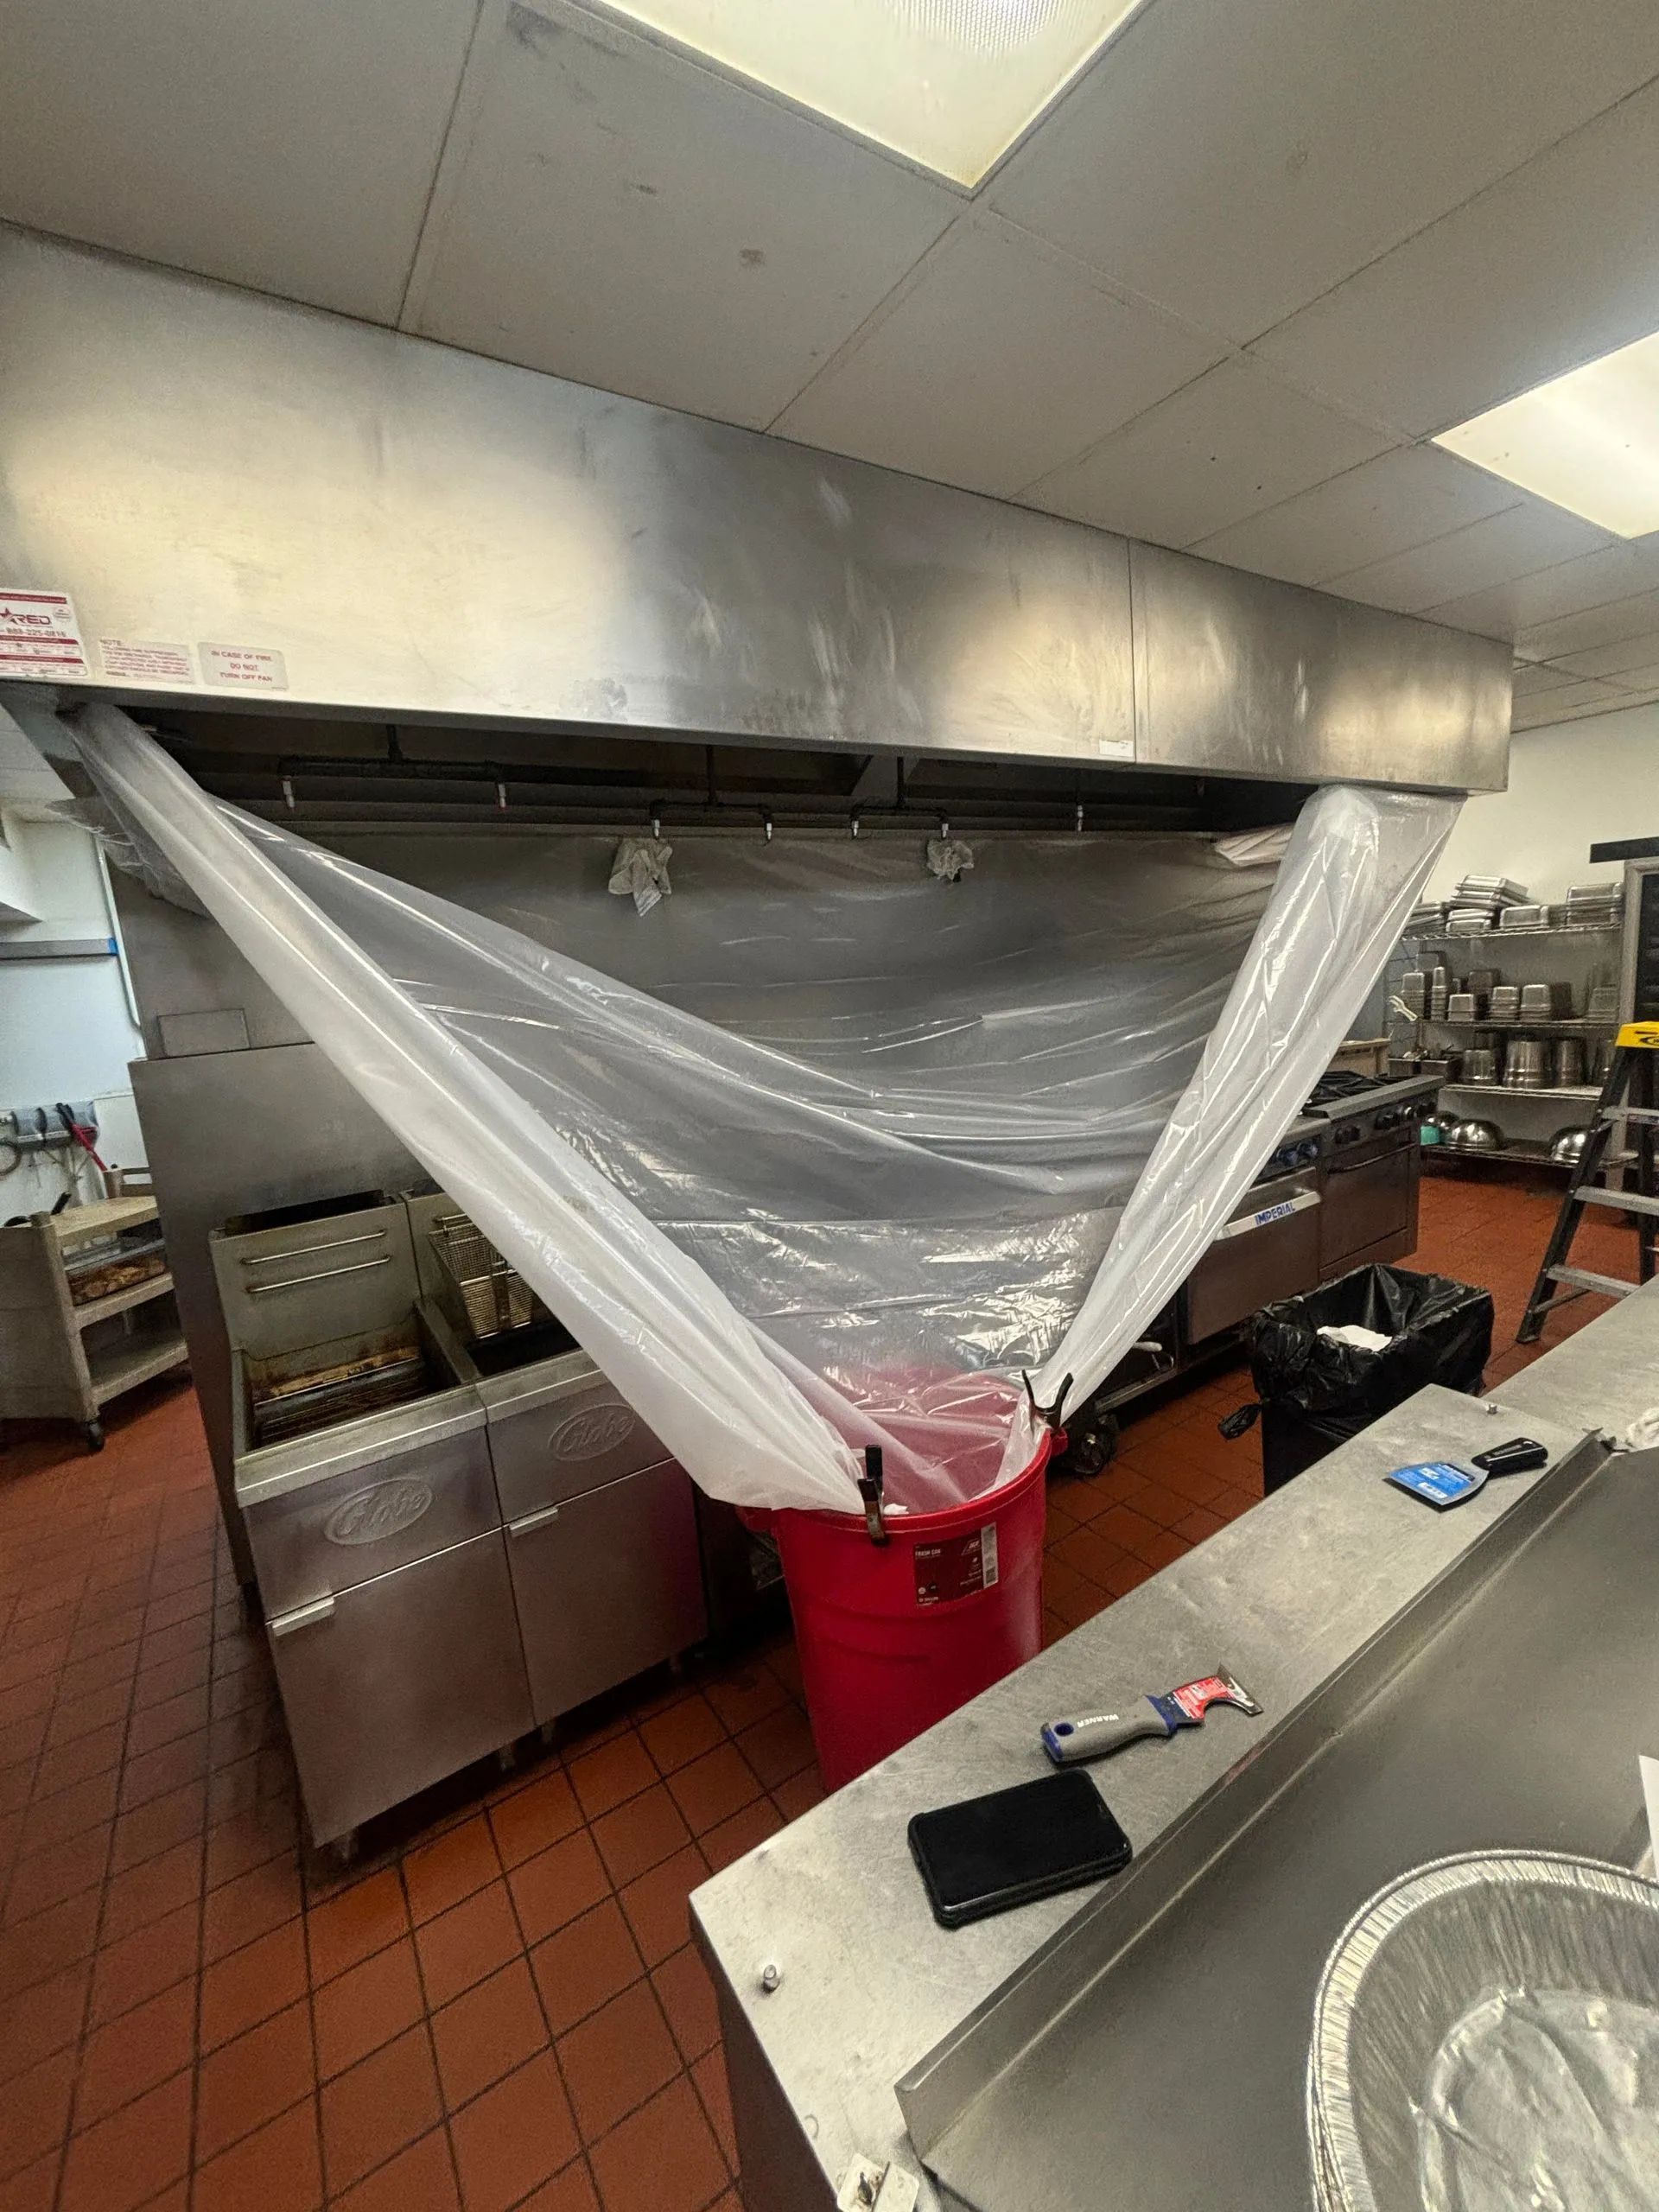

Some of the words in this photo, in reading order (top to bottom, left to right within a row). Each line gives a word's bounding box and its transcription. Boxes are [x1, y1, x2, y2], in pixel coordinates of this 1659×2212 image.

[221, 651, 242, 659] CASE
[229, 662, 241, 671] DO
[243, 663, 259, 671] NOT
[1255, 1201, 1296, 1225] IMPERIAL
[1077, 1713, 1120, 1728] WARNER
